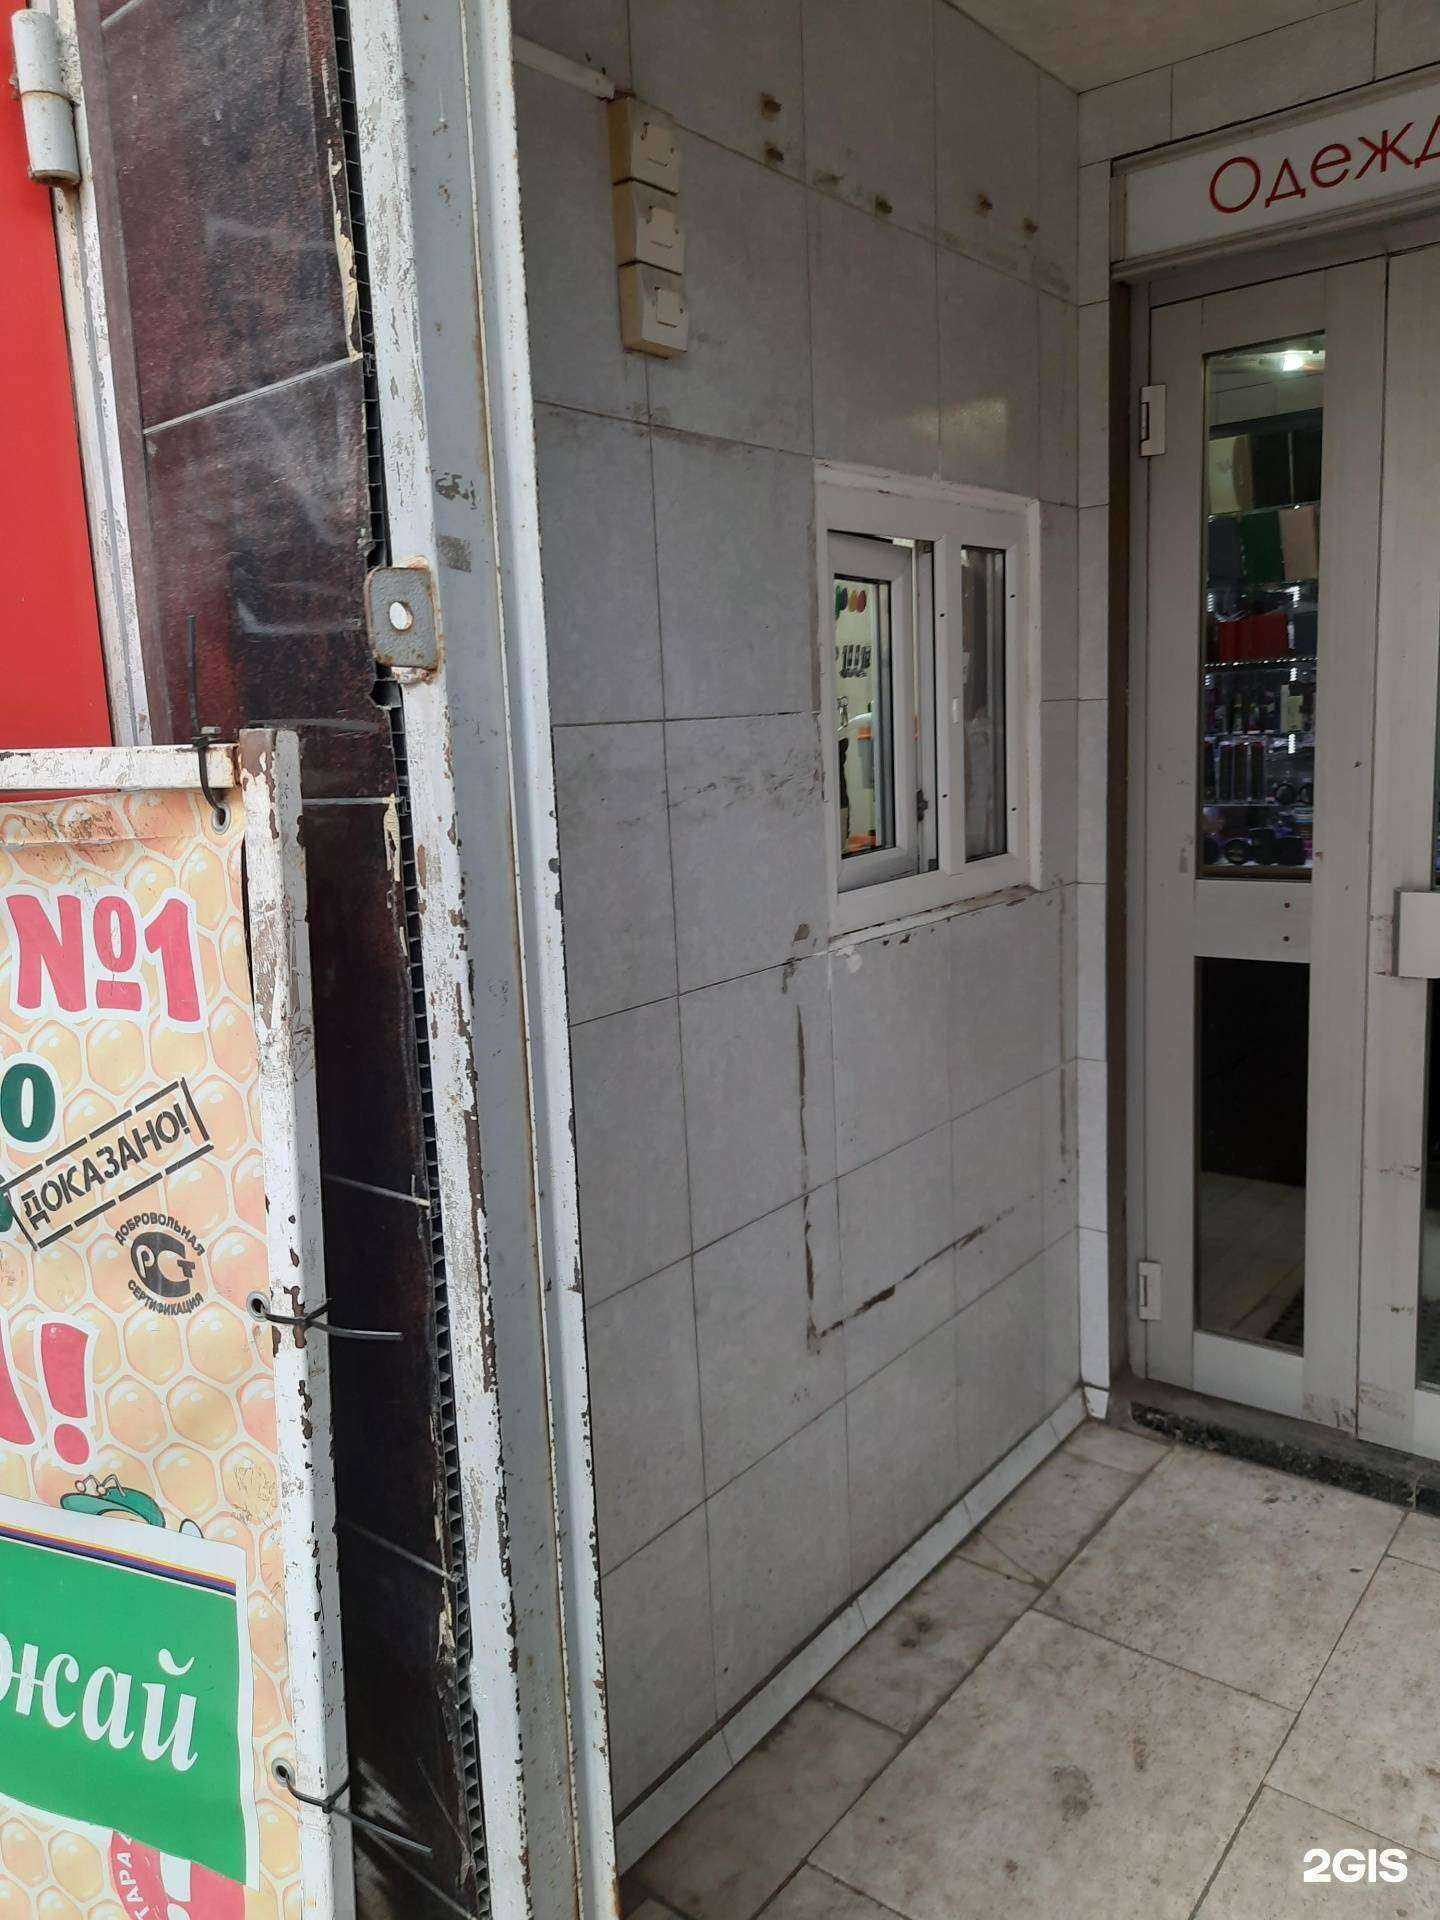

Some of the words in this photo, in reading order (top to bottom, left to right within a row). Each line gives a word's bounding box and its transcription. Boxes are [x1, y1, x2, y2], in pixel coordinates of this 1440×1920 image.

[21, 1103, 191, 1230] ДОКАЗАНО!
[115, 1212, 206, 1256] ДОБРОВОЛЬНАЯ
[128, 1279, 204, 1316] СЕРТИФИКАЦИЯ
